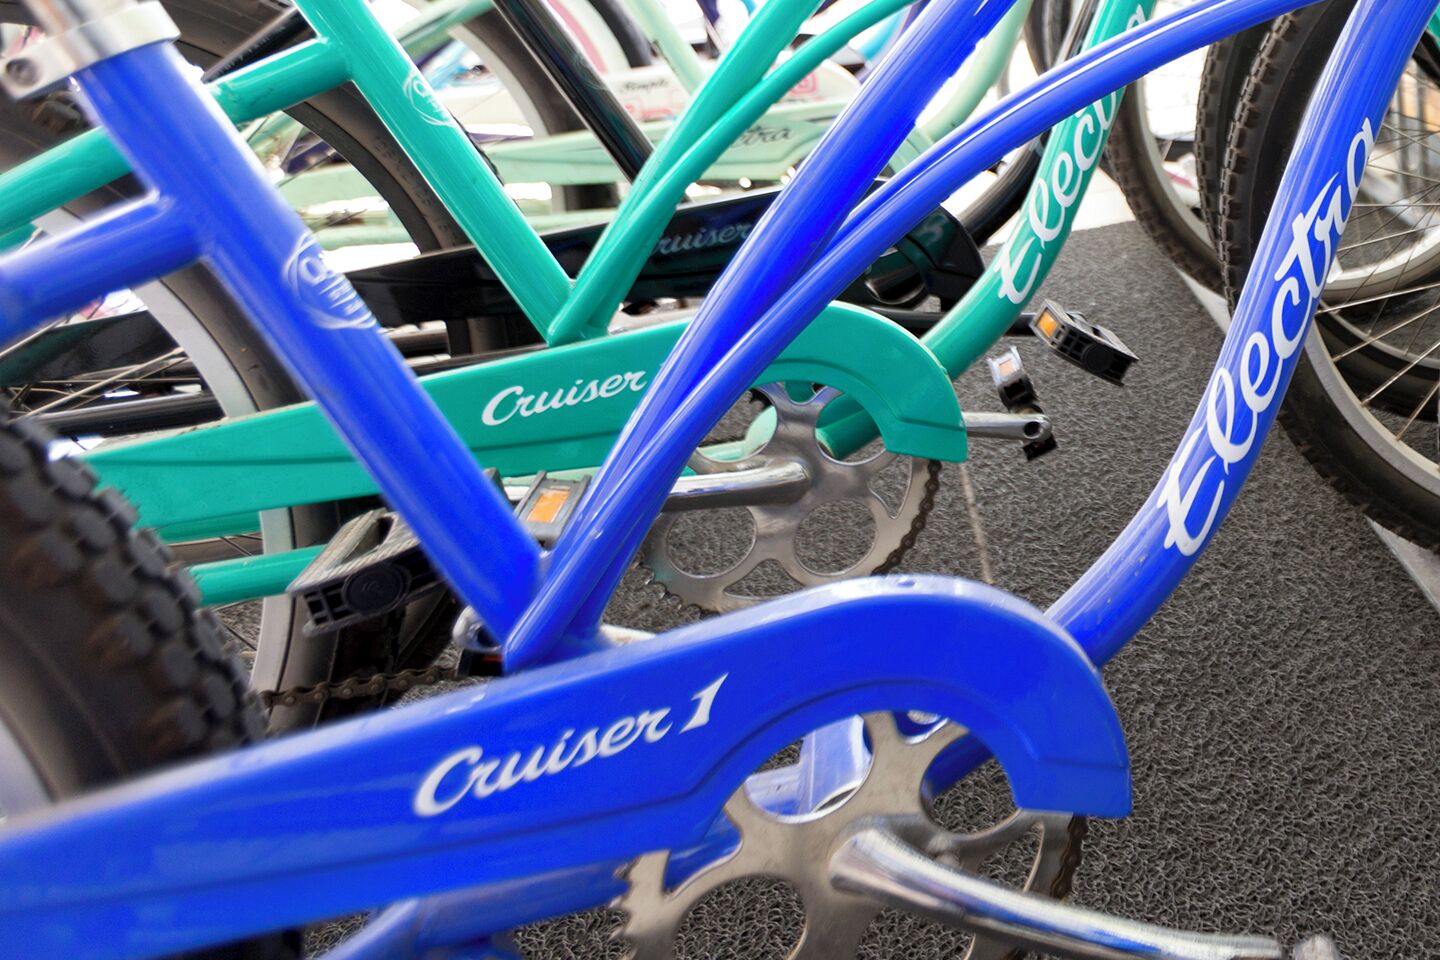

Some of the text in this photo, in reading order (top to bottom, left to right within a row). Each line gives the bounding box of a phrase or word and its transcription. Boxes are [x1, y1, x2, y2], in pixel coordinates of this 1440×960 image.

[656, 222, 752, 255] ruiser
[1156, 116, 1377, 557] Electra
[481, 370, 648, 426] Cruiser
[412, 671, 730, 818] Cruiser 1
